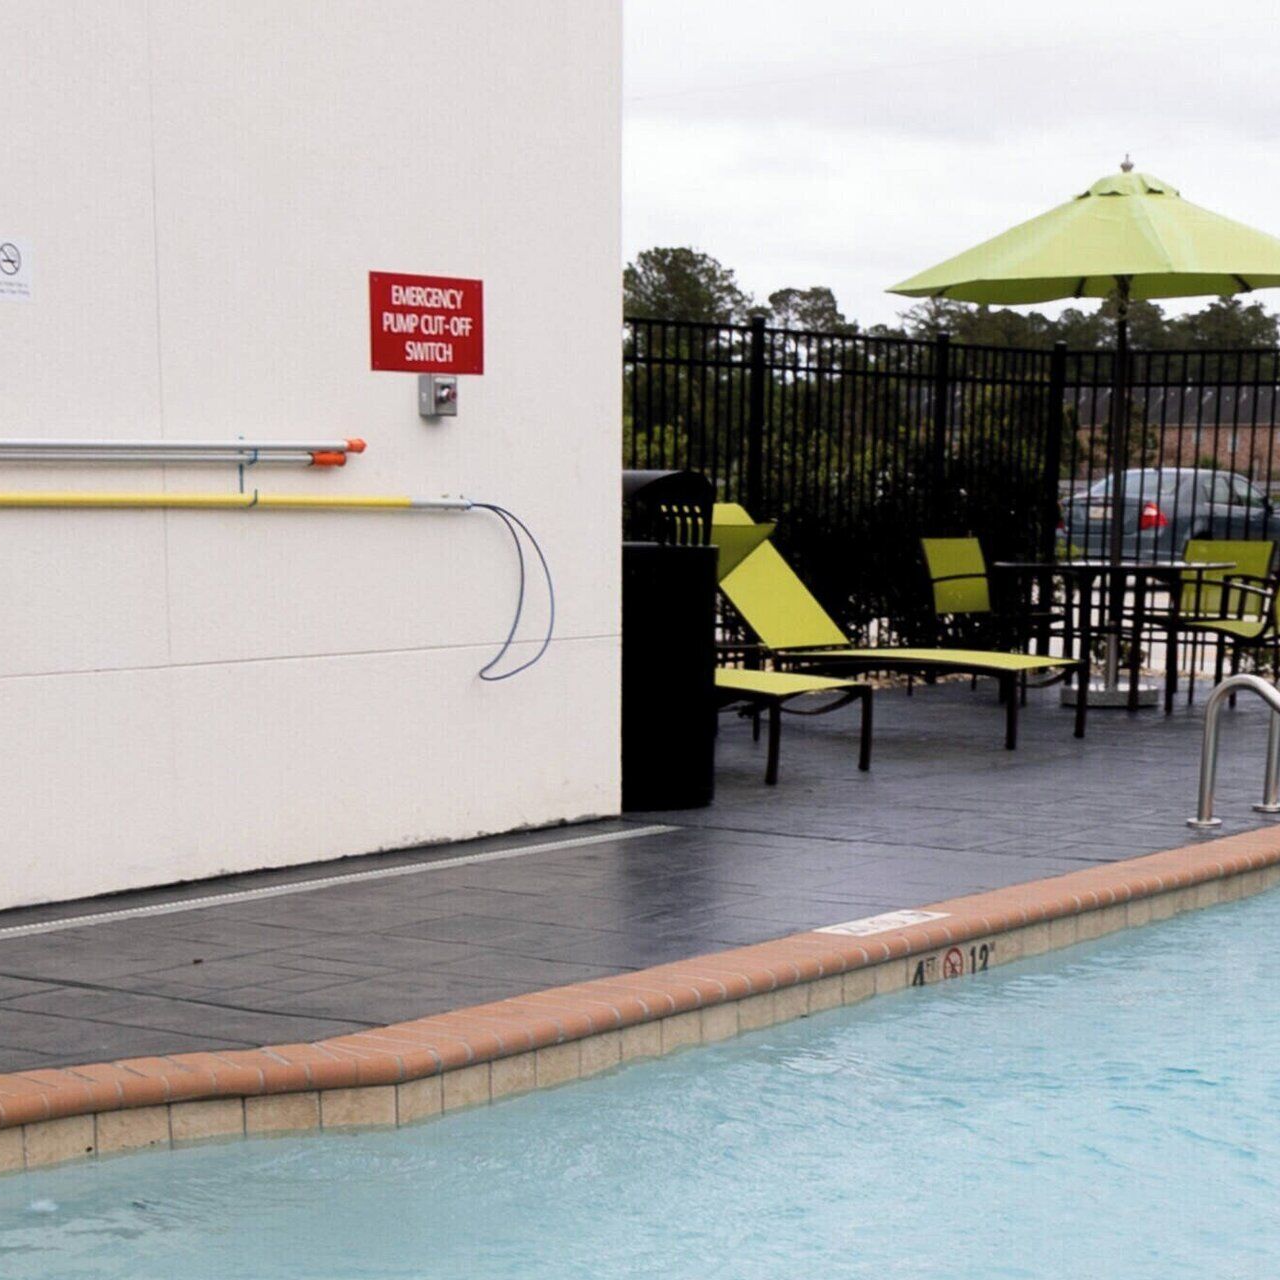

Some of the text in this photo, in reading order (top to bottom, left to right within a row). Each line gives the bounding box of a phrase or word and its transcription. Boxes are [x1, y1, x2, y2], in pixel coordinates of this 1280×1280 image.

[391, 284, 464, 310] EMERGENCY
[382, 311, 473, 337] PUMP CUT-OFF
[404, 341, 453, 363] SWITCH
